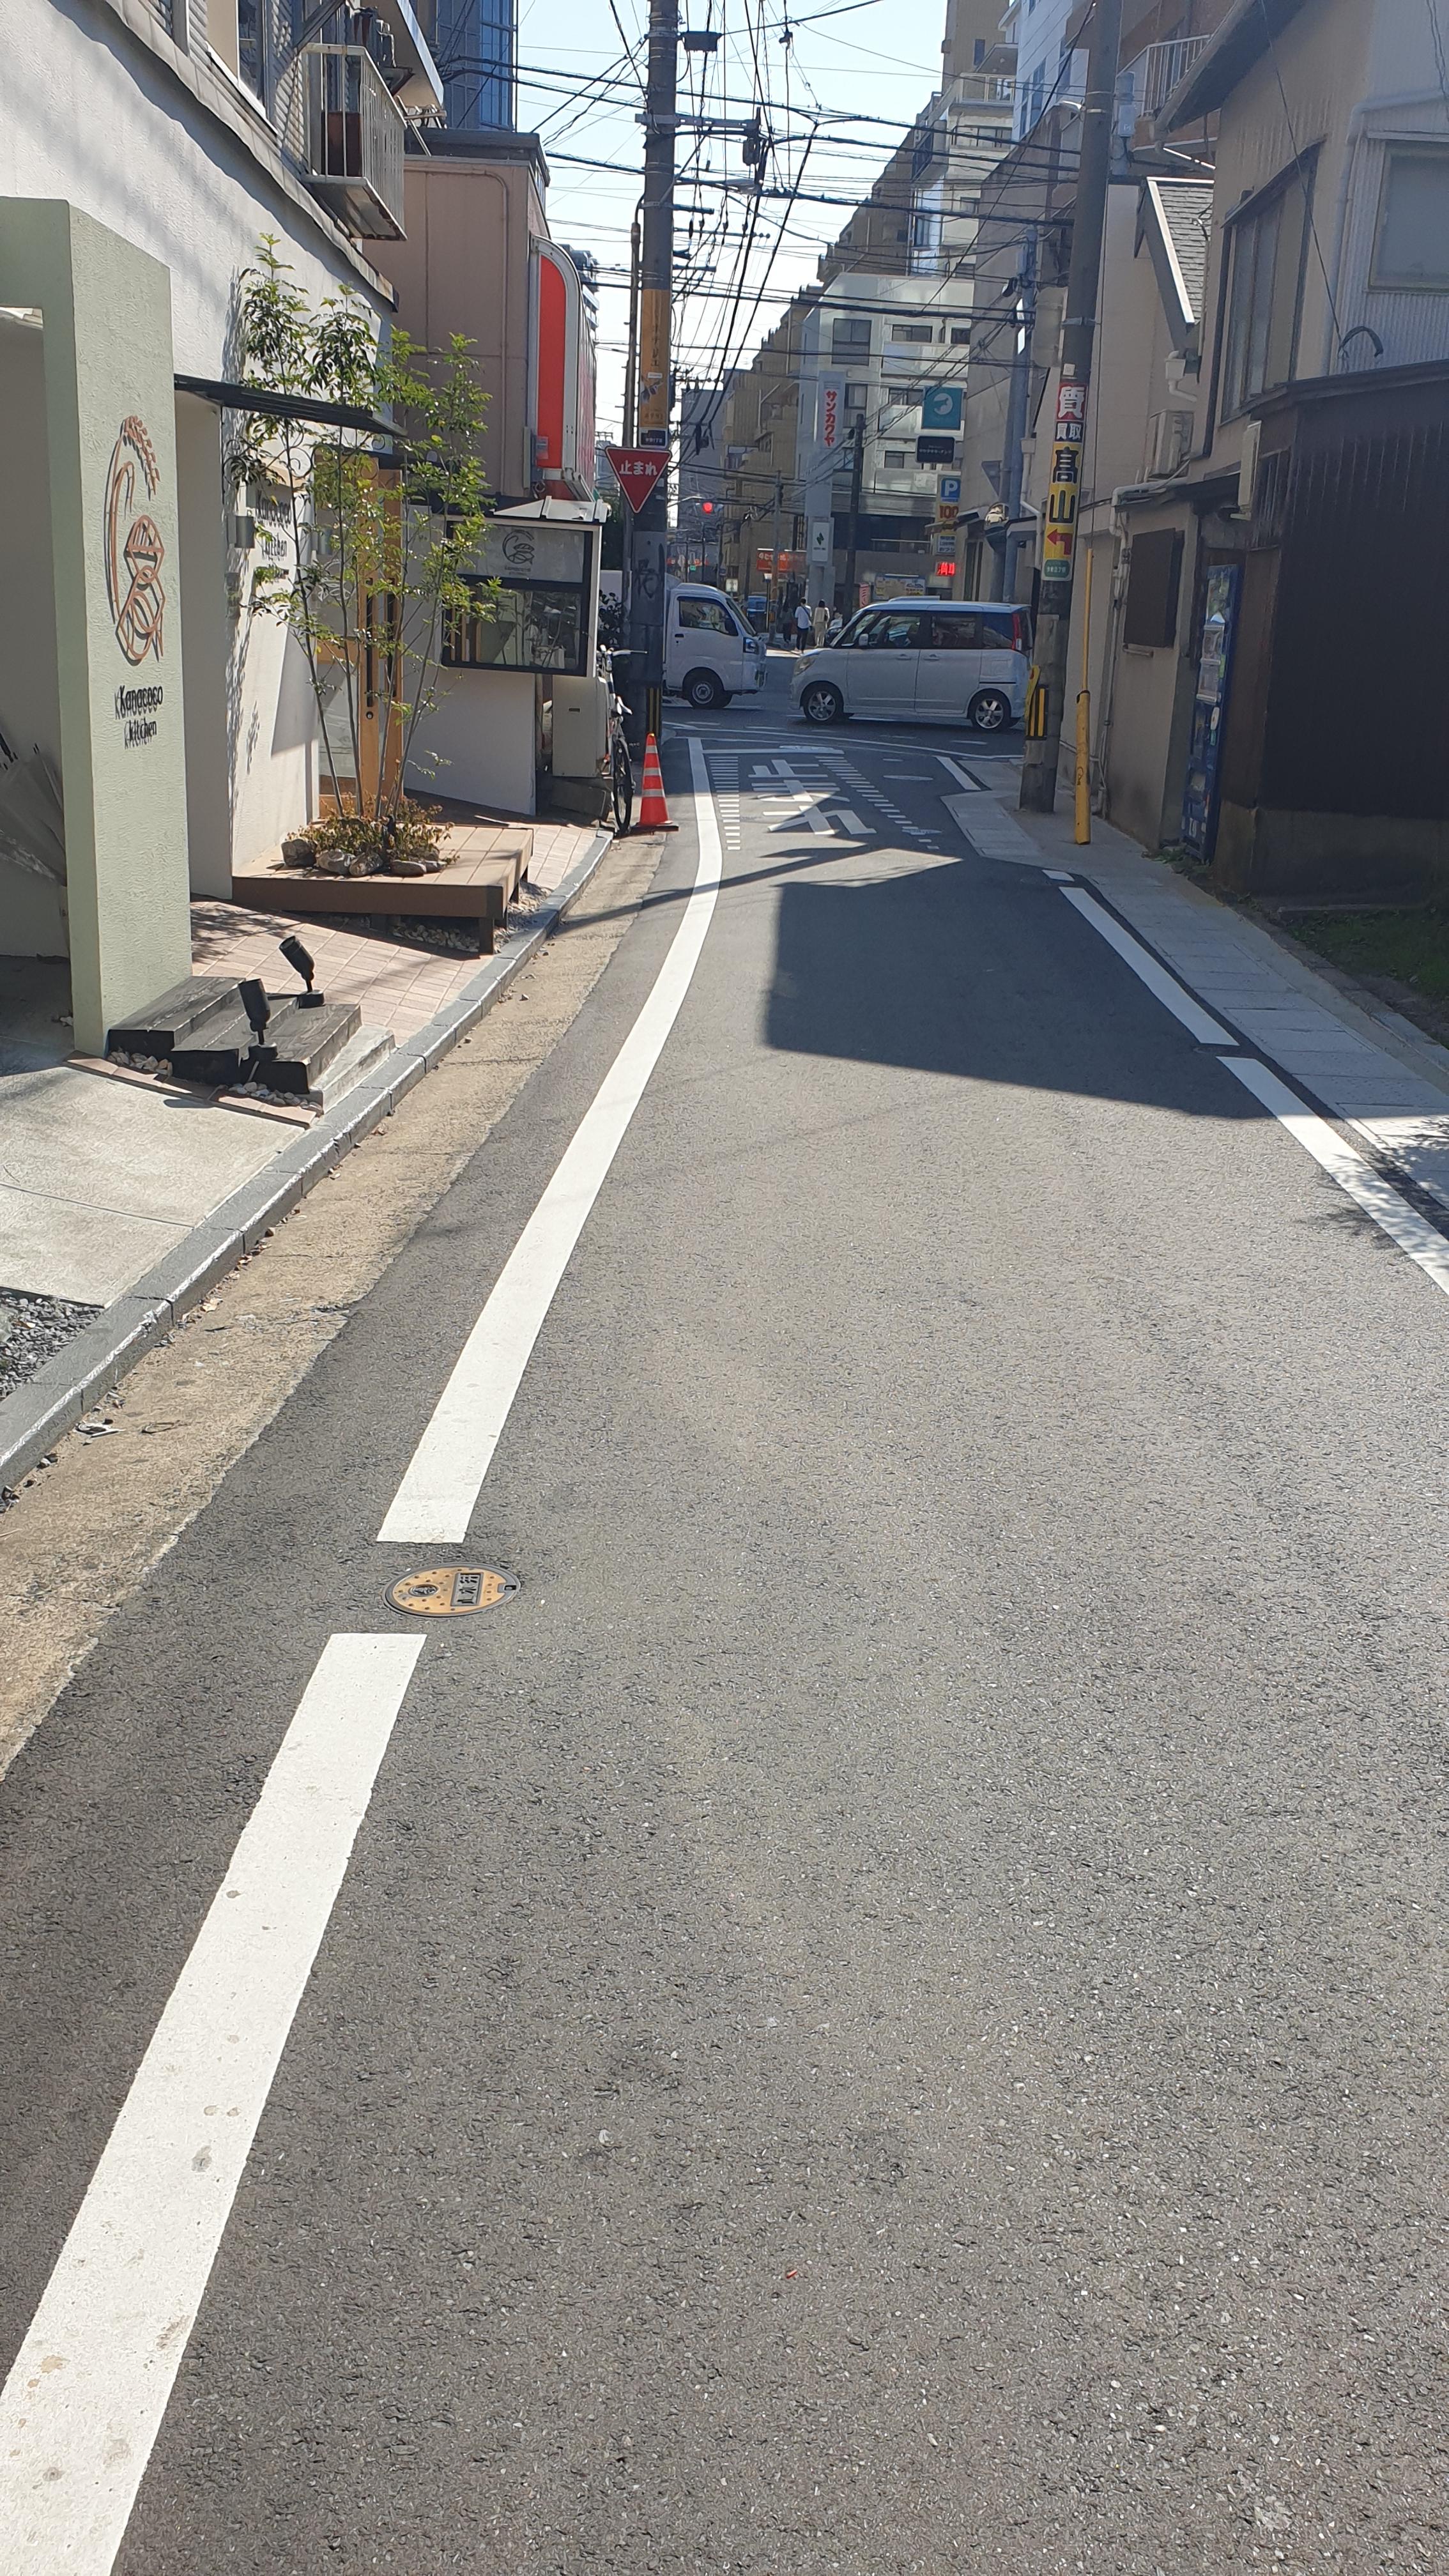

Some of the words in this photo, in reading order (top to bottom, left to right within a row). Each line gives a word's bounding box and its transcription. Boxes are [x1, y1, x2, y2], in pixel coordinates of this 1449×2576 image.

[824, 390, 838, 447] サンカクヤ
[1056, 423, 1082, 440] 買取
[619, 459, 658, 475] 止まれ
[1049, 446, 1080, 524] 高山
[119, 685, 163, 712] Kanacoco
[128, 717, 157, 741] kitchen
[748, 760, 877, 834] 止まれ
